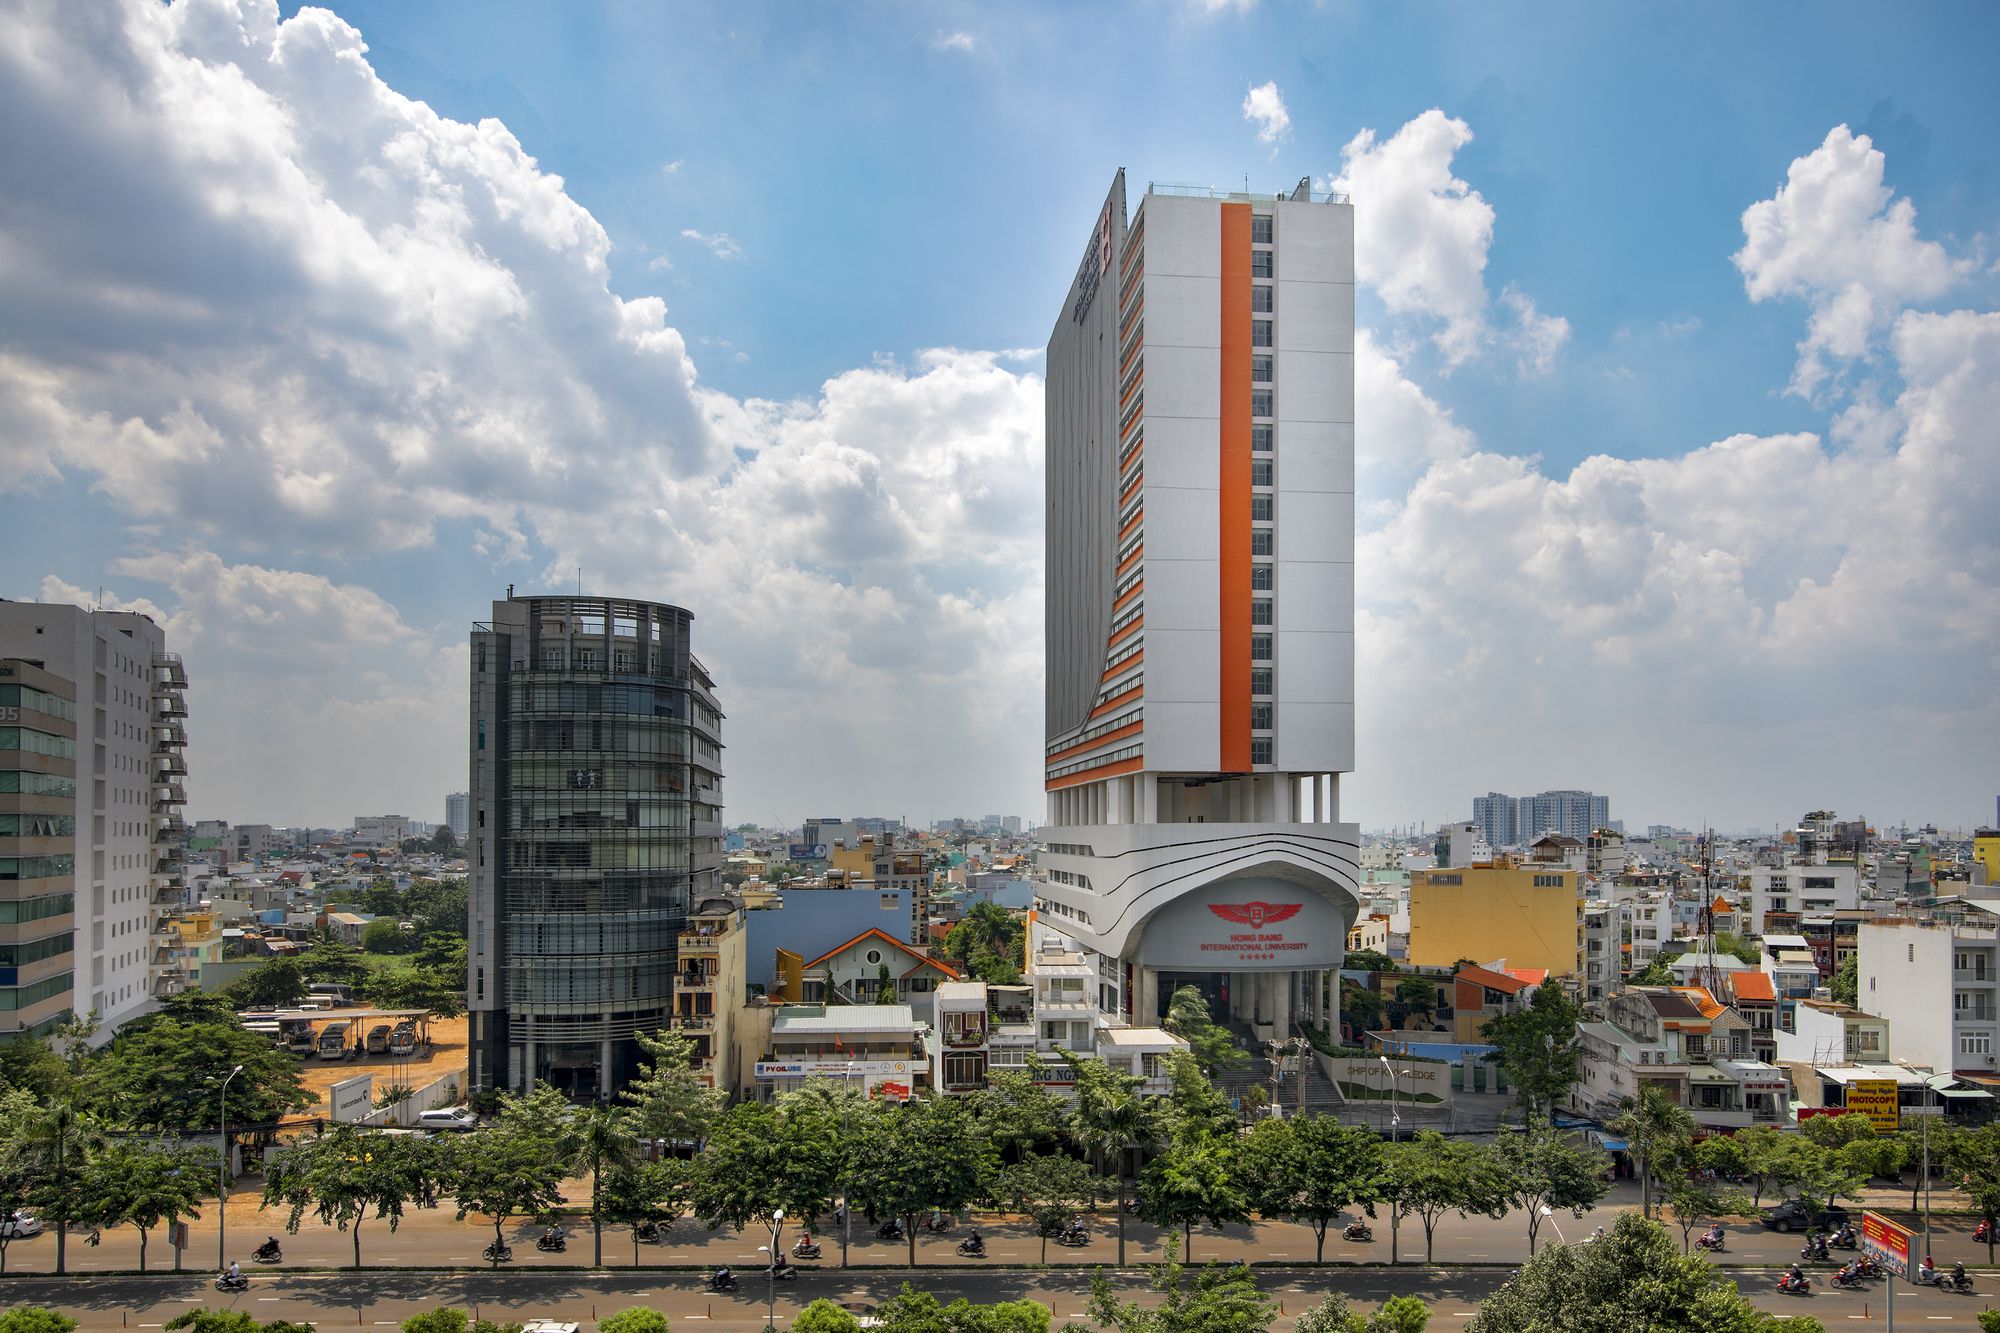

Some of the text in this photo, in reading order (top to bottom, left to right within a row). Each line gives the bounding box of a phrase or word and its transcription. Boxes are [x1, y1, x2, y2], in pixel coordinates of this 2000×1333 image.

[1230, 933, 1283, 942] HONG BANG
[1200, 942, 1309, 951] INTERNATIONAL UNIVERSITY
[1347, 1066, 1366, 1075] SHIP
[1368, 1067, 1379, 1076] OF
[1848, 1096, 1896, 1104] PHOTOCOPY
